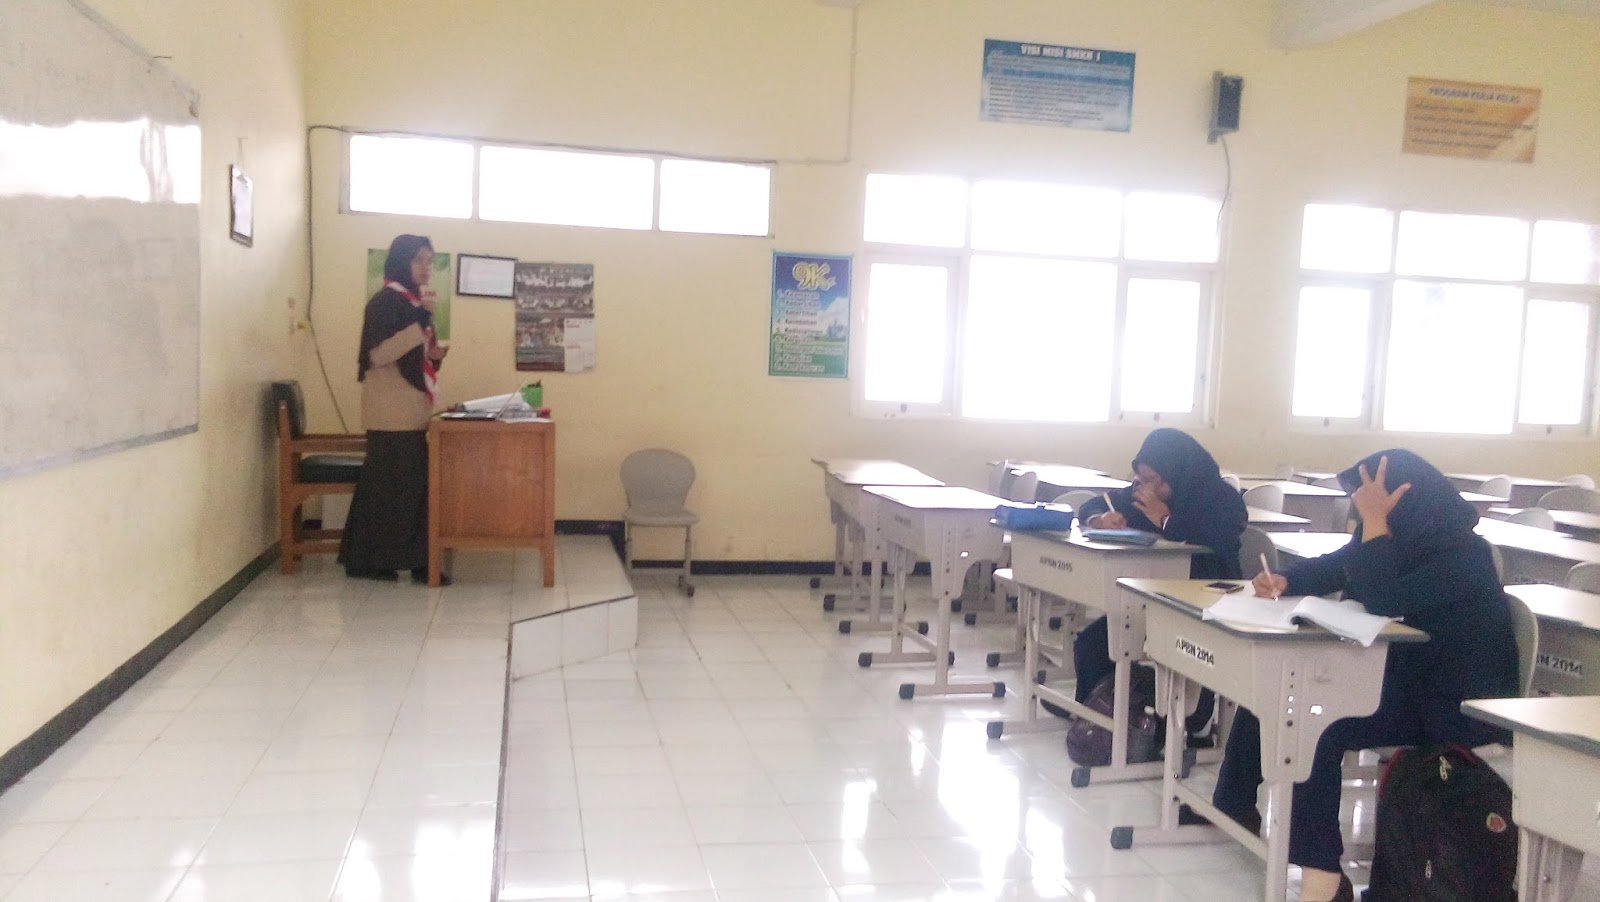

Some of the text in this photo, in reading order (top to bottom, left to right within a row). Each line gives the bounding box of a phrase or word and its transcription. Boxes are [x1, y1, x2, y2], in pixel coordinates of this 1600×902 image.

[1020, 44, 1041, 56] VISI
[1042, 46, 1064, 58] MISI
[792, 262, 836, 290] 9K
[1175, 638, 1215, 666] APBN 2014
